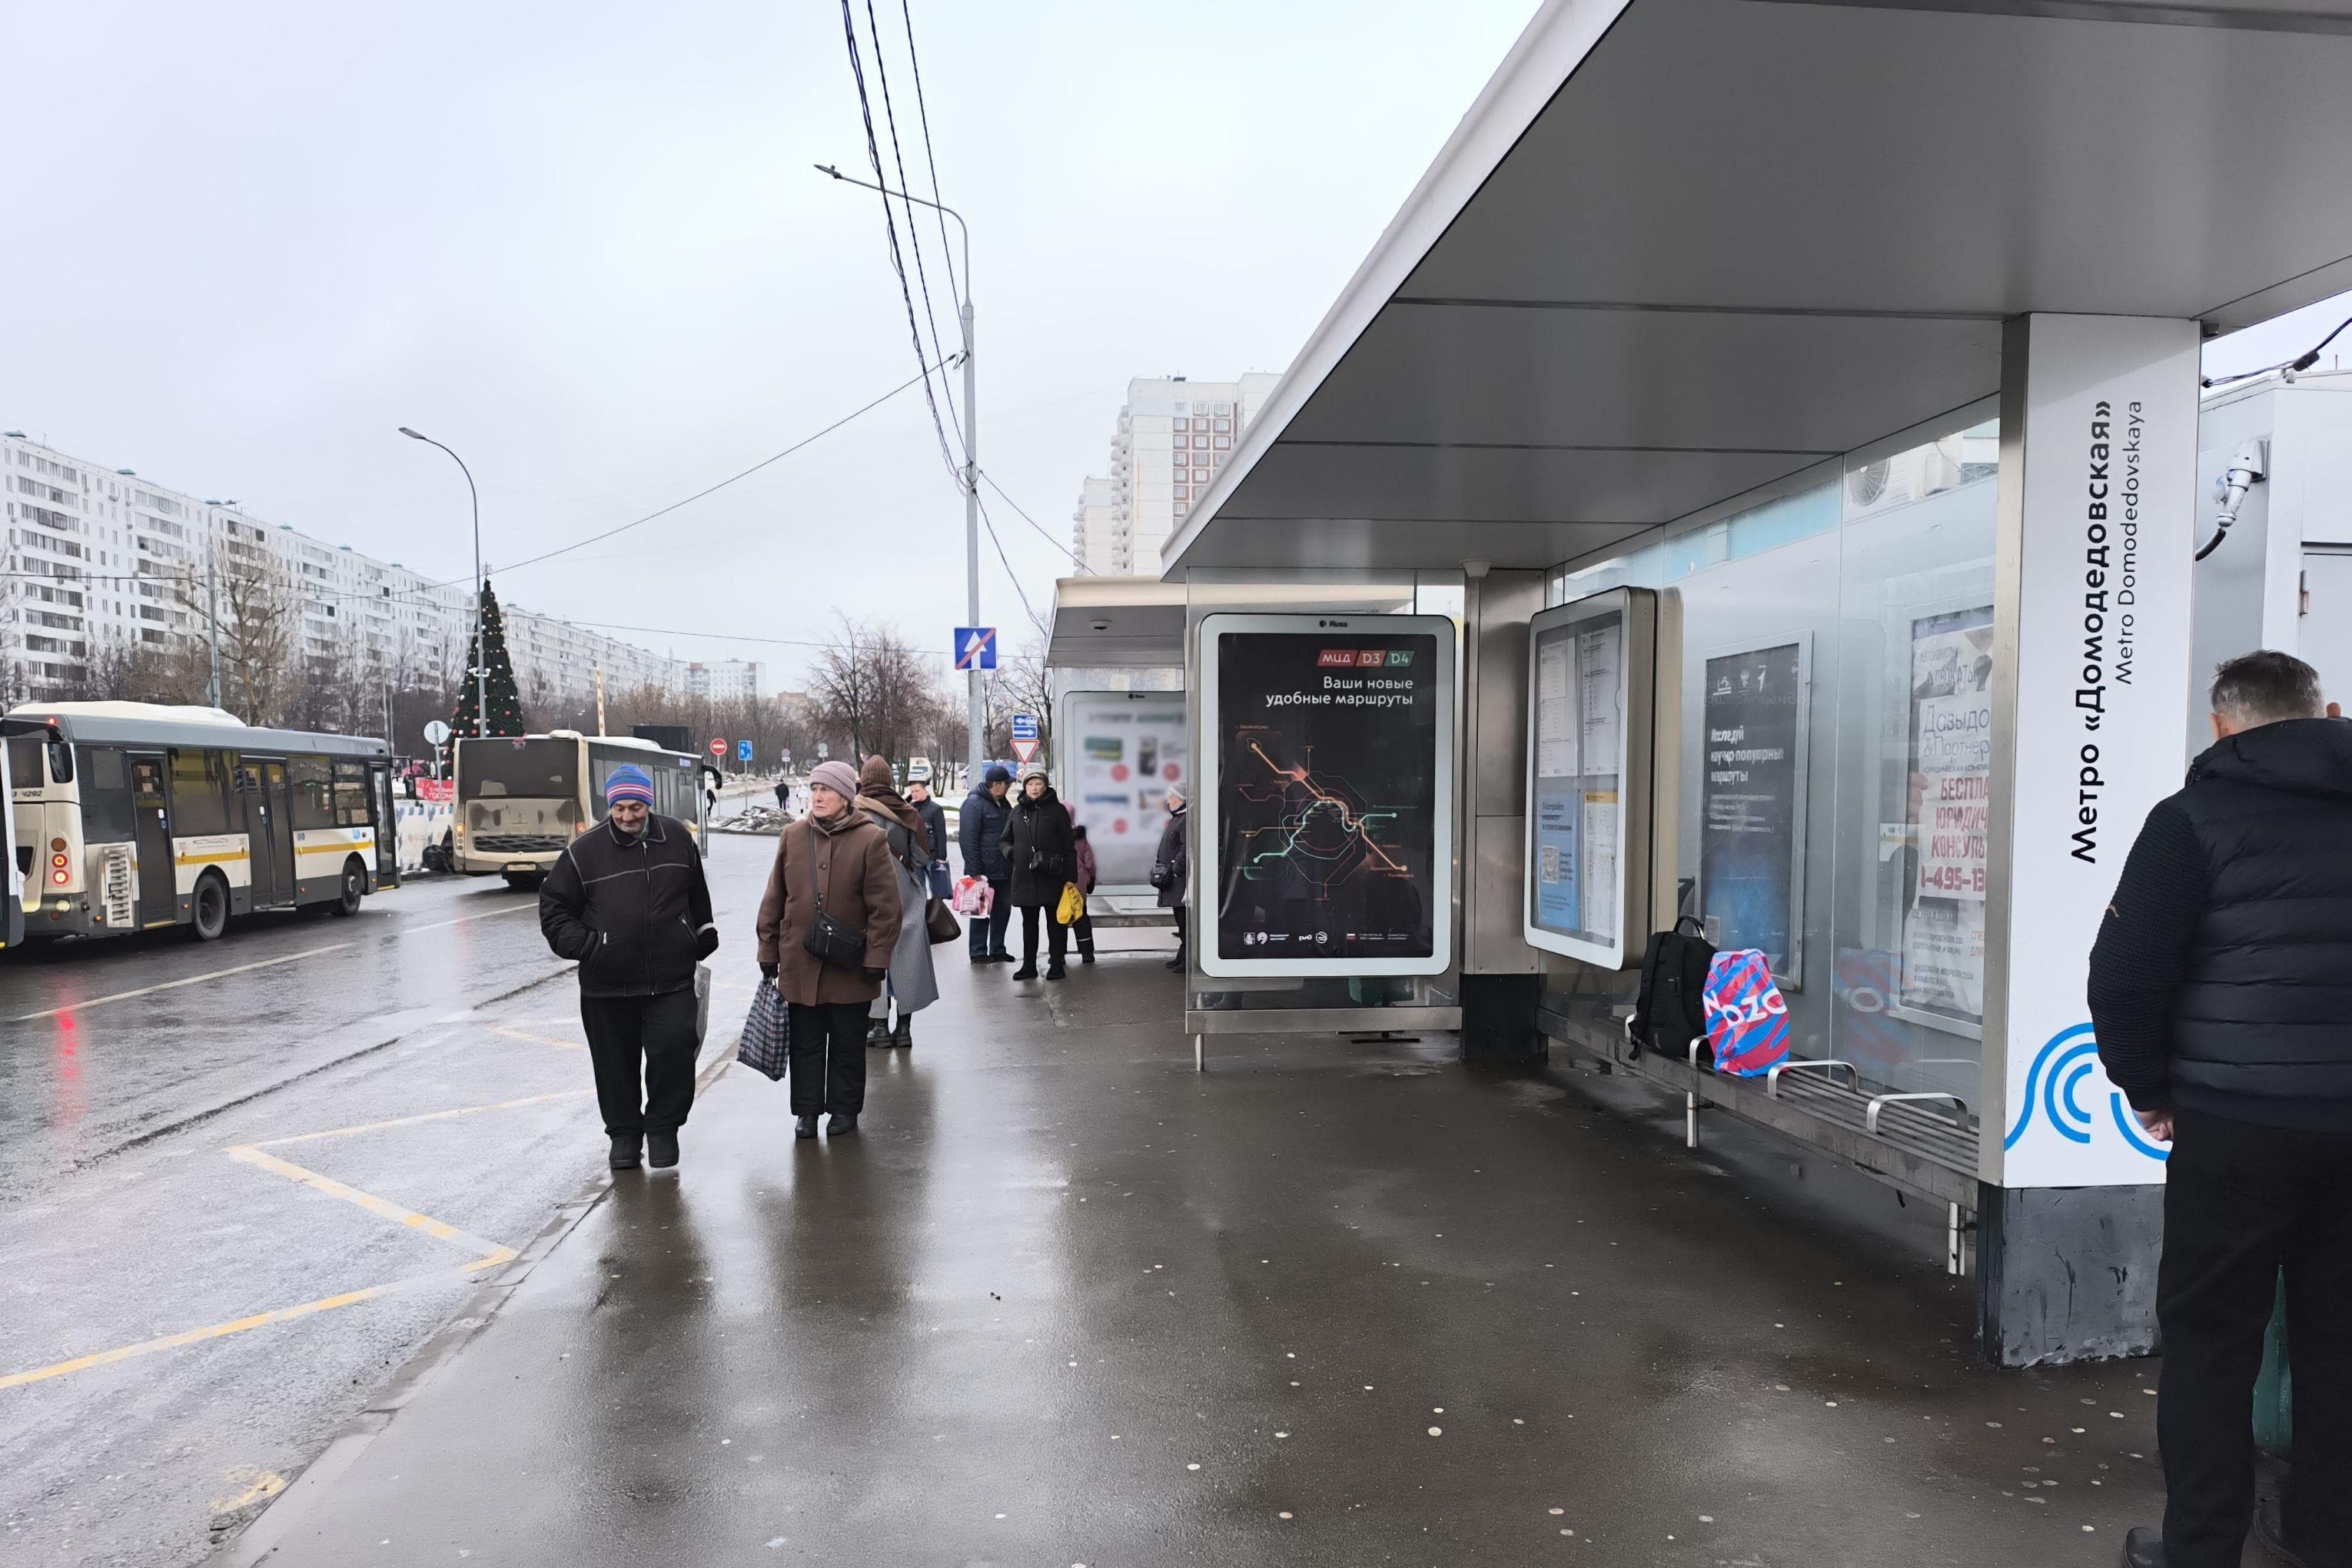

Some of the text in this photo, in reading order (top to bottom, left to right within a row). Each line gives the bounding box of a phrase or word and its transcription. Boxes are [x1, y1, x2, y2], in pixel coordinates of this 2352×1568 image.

[2115, 401, 2145, 685] Metro Domodedovskaya
[2071, 400, 2111, 864] Метро «Домодедовская»
[1362, 654, 1380, 664] D3
[1390, 654, 1409, 664] D4
[1324, 676, 1414, 689] Ваши новые
[1266, 691, 1413, 707] удобные маршруты
[1941, 776, 1991, 801] БЕСПЛА
[1936, 806, 1988, 832] ЮРИДИЧ
[1931, 835, 1985, 859] КОНСУЛЬ
